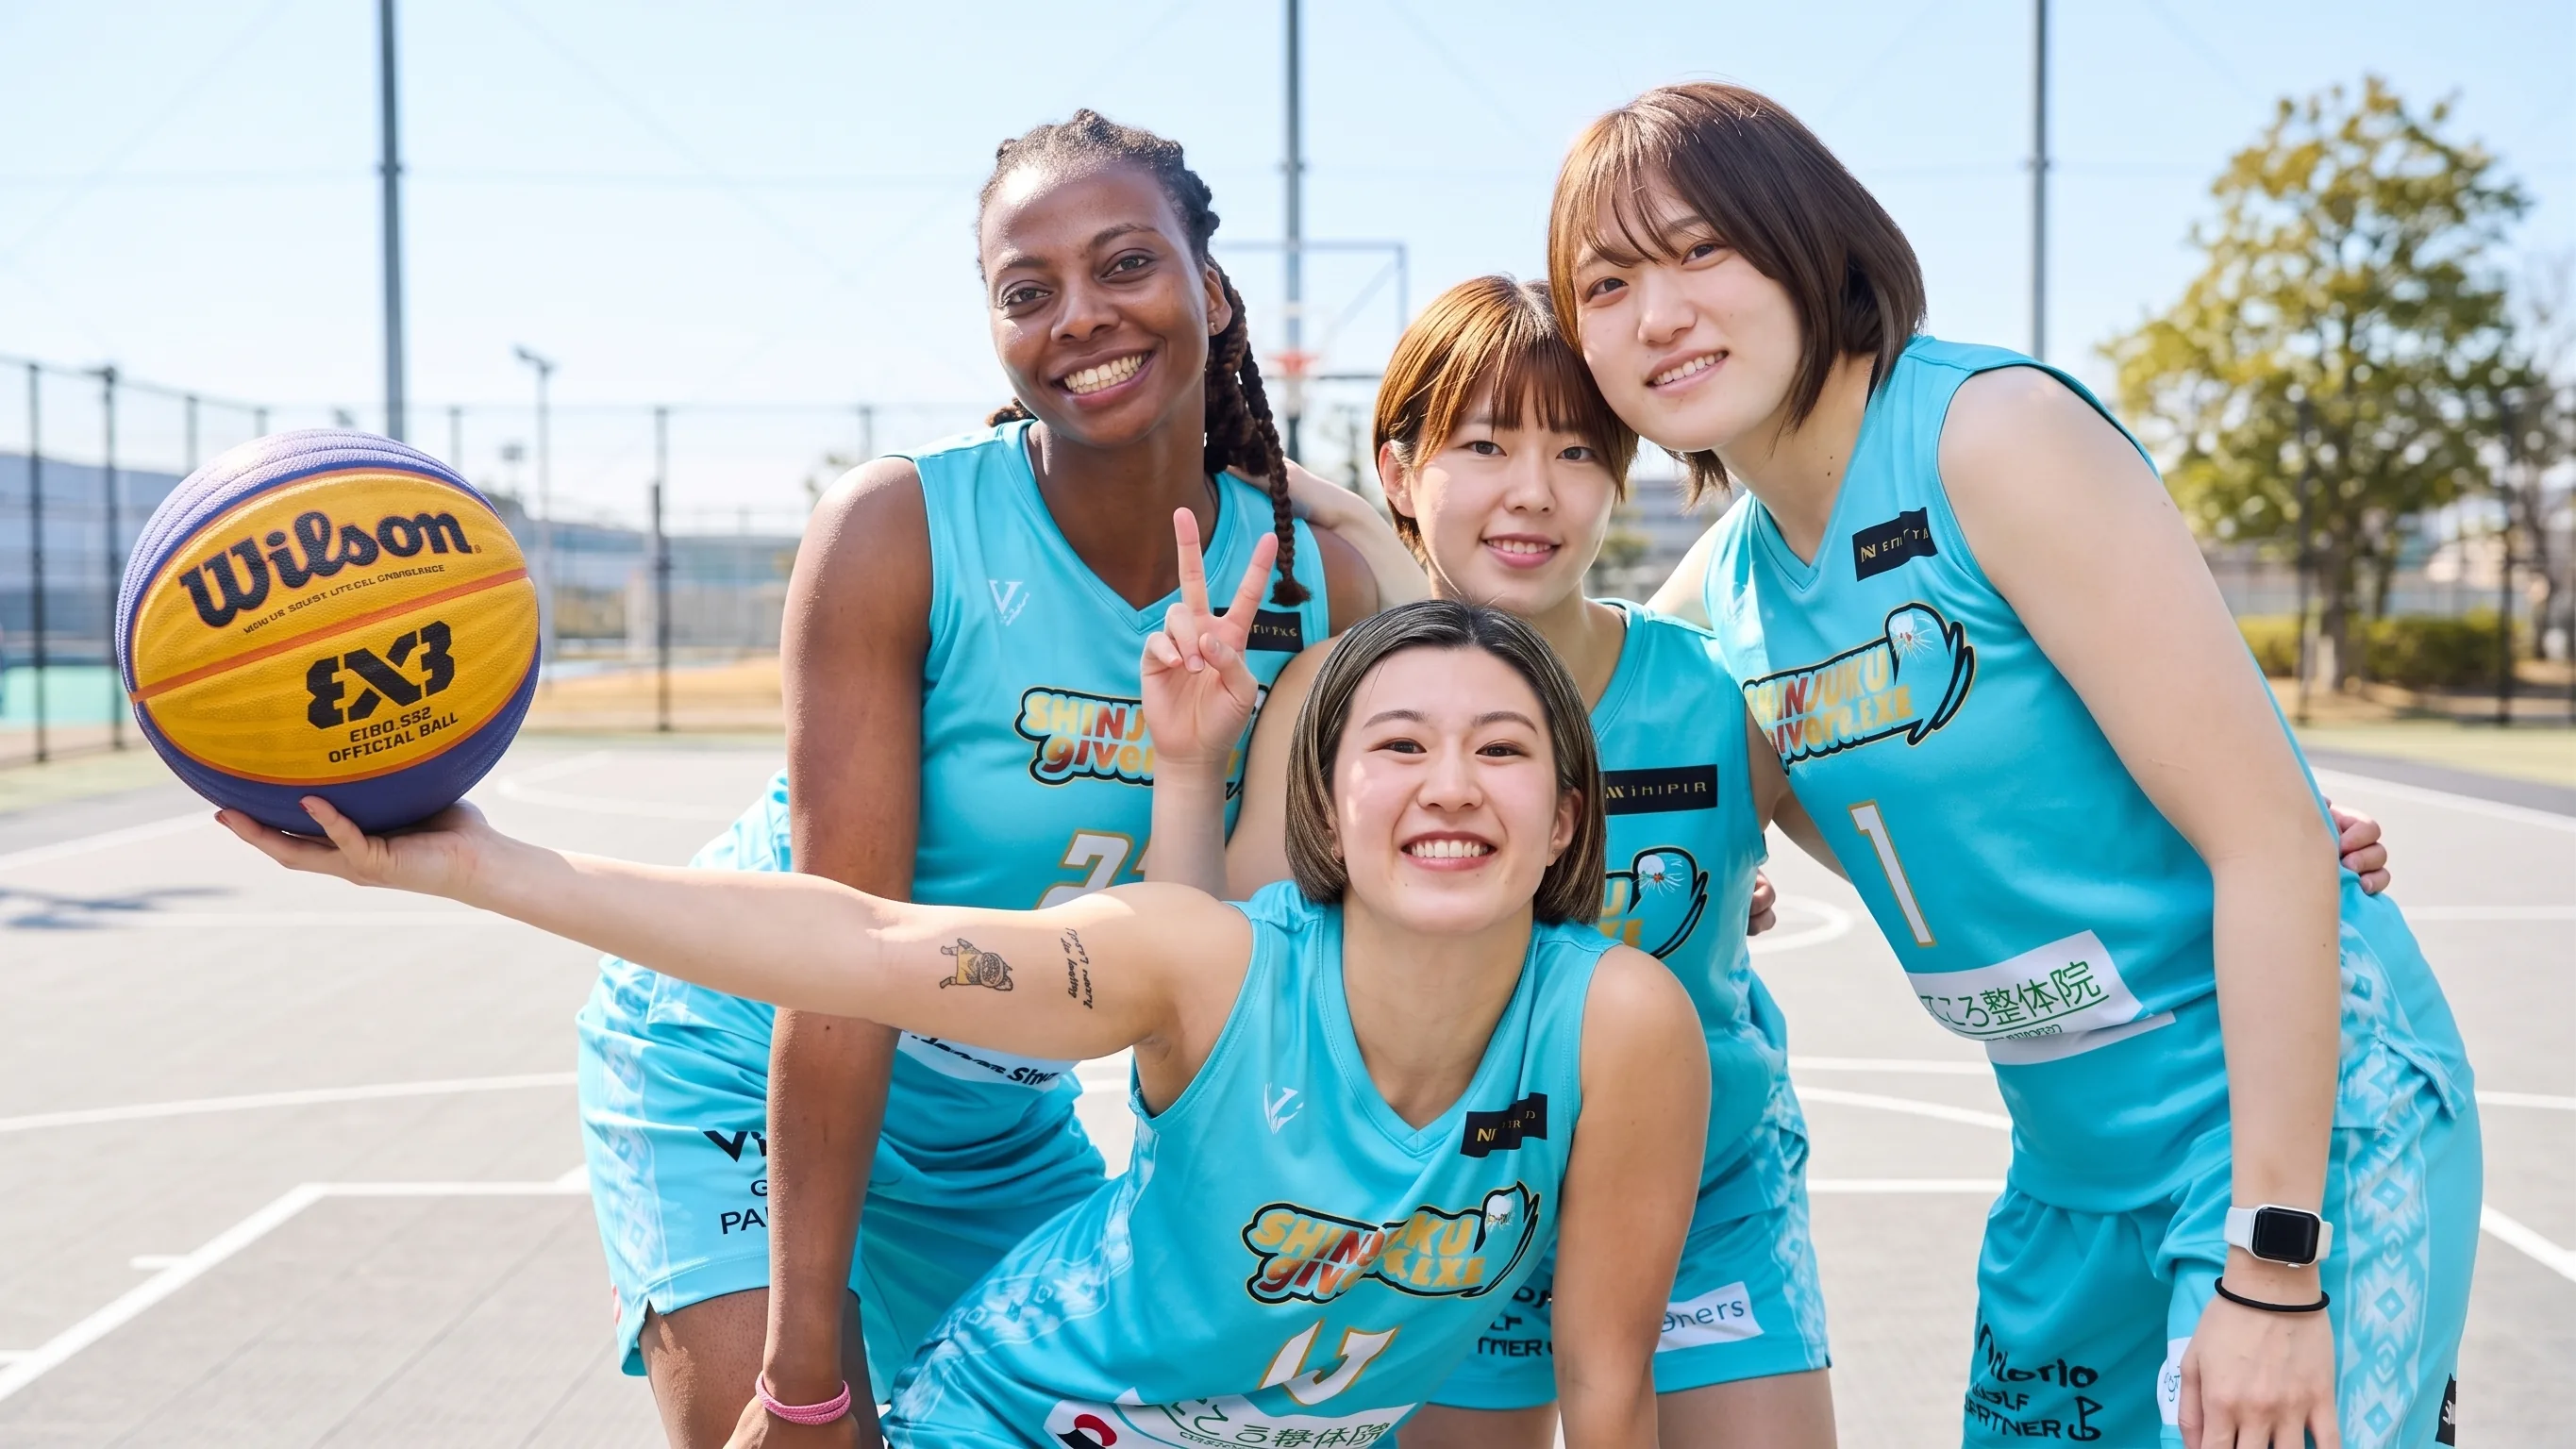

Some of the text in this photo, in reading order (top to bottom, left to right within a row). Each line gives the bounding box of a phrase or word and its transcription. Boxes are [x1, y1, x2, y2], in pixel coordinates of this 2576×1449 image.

[178, 510, 473, 630] Wilson
[328, 712, 459, 763] OFFICIAL BALL
[1025, 694, 1146, 742] SHINJ
[1848, 799, 1937, 948] 1
